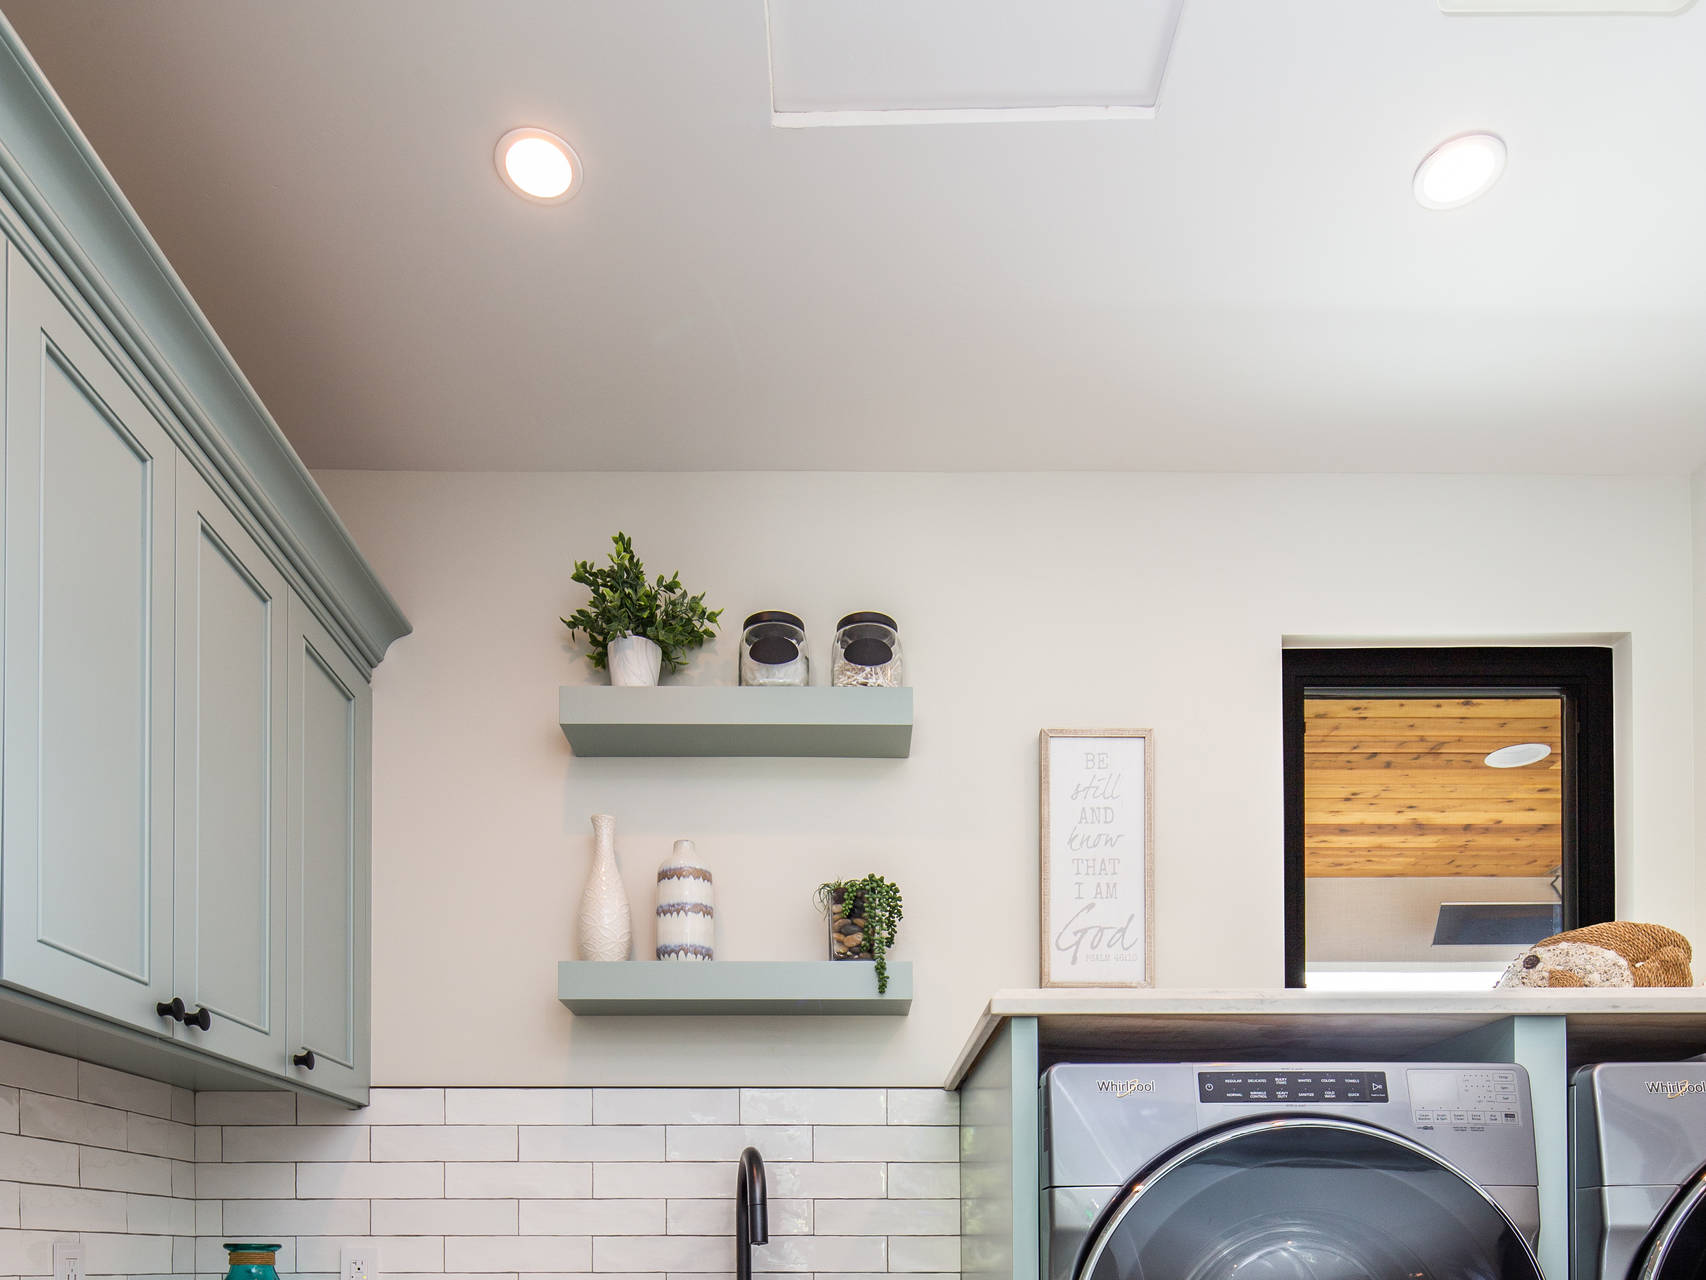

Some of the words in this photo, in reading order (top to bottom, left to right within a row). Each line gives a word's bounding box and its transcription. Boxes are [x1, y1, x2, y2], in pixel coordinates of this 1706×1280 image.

[1084, 752, 1109, 770] BE
[1070, 773, 1121, 801] still
[1078, 806, 1114, 824] AND
[1067, 826, 1126, 851] know
[1072, 858, 1120, 876] THAT
[1074, 882, 1084, 900] I
[1094, 882, 1118, 900] AM
[1055, 902, 1138, 965] God
[1096, 1079, 1155, 1098] Whirlpool
[1645, 1080, 1706, 1098] Whirlpool
